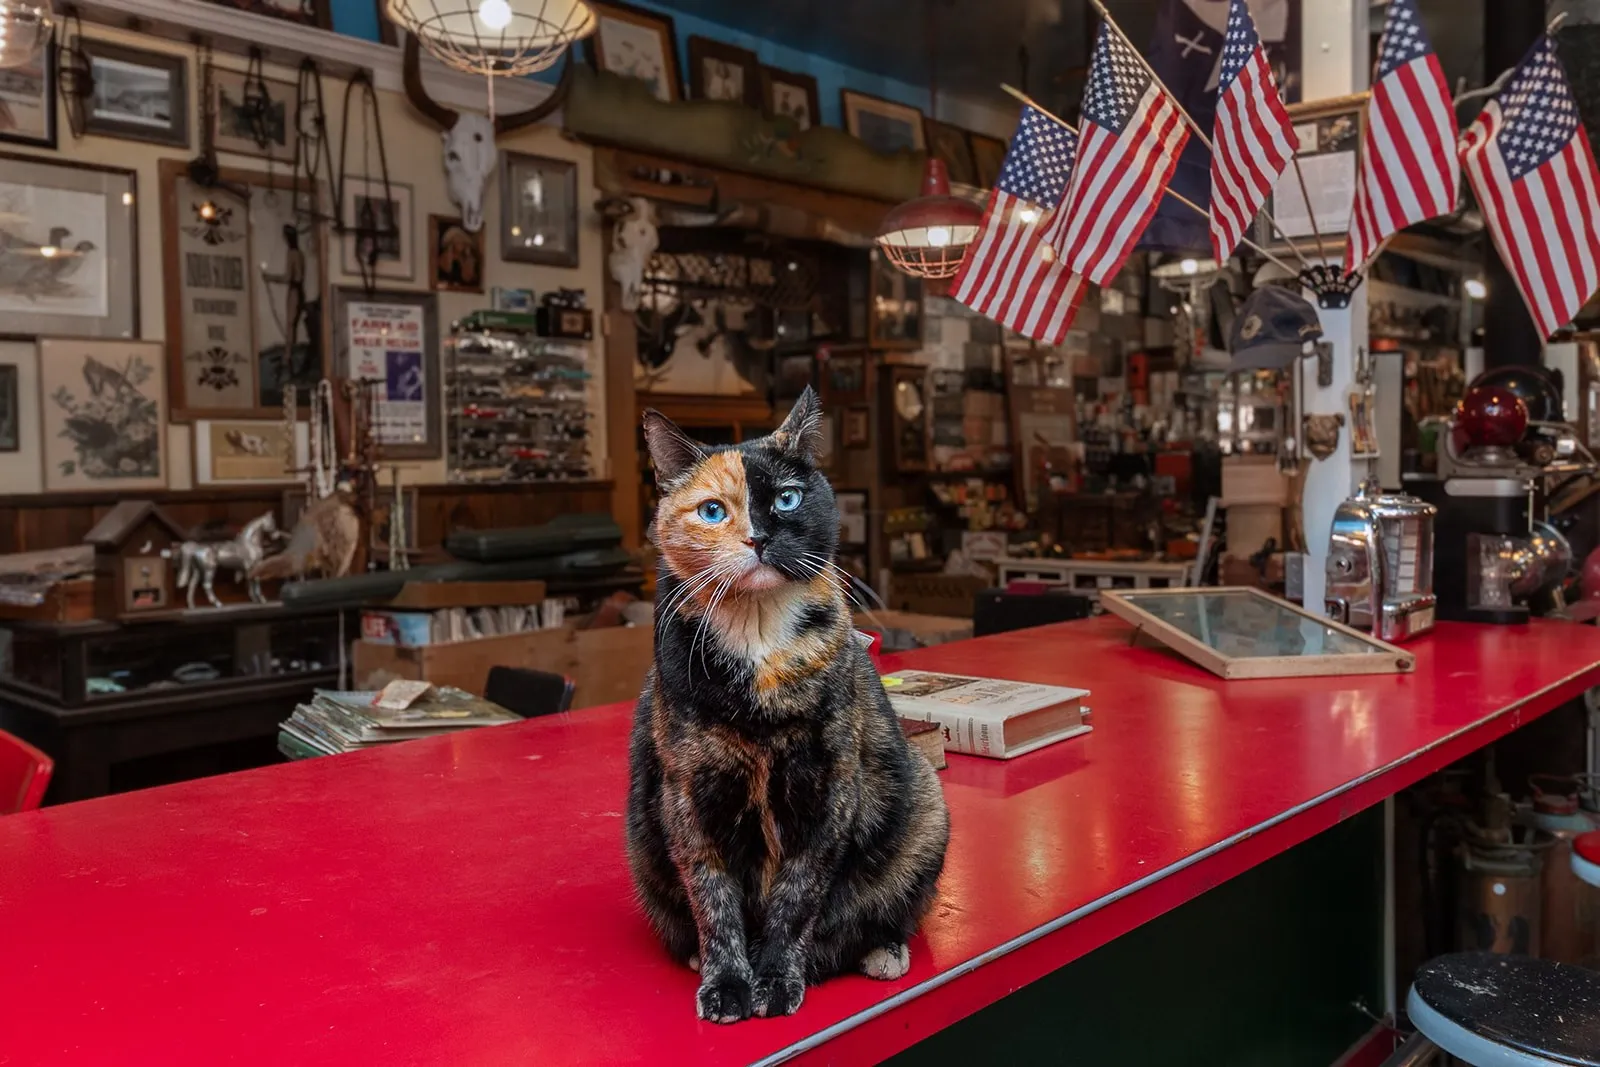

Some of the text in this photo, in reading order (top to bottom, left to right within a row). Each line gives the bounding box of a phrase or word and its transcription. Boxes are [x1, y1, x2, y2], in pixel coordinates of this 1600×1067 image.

[351, 318, 418, 331] FARM AID
[362, 616, 386, 637] LIFE
